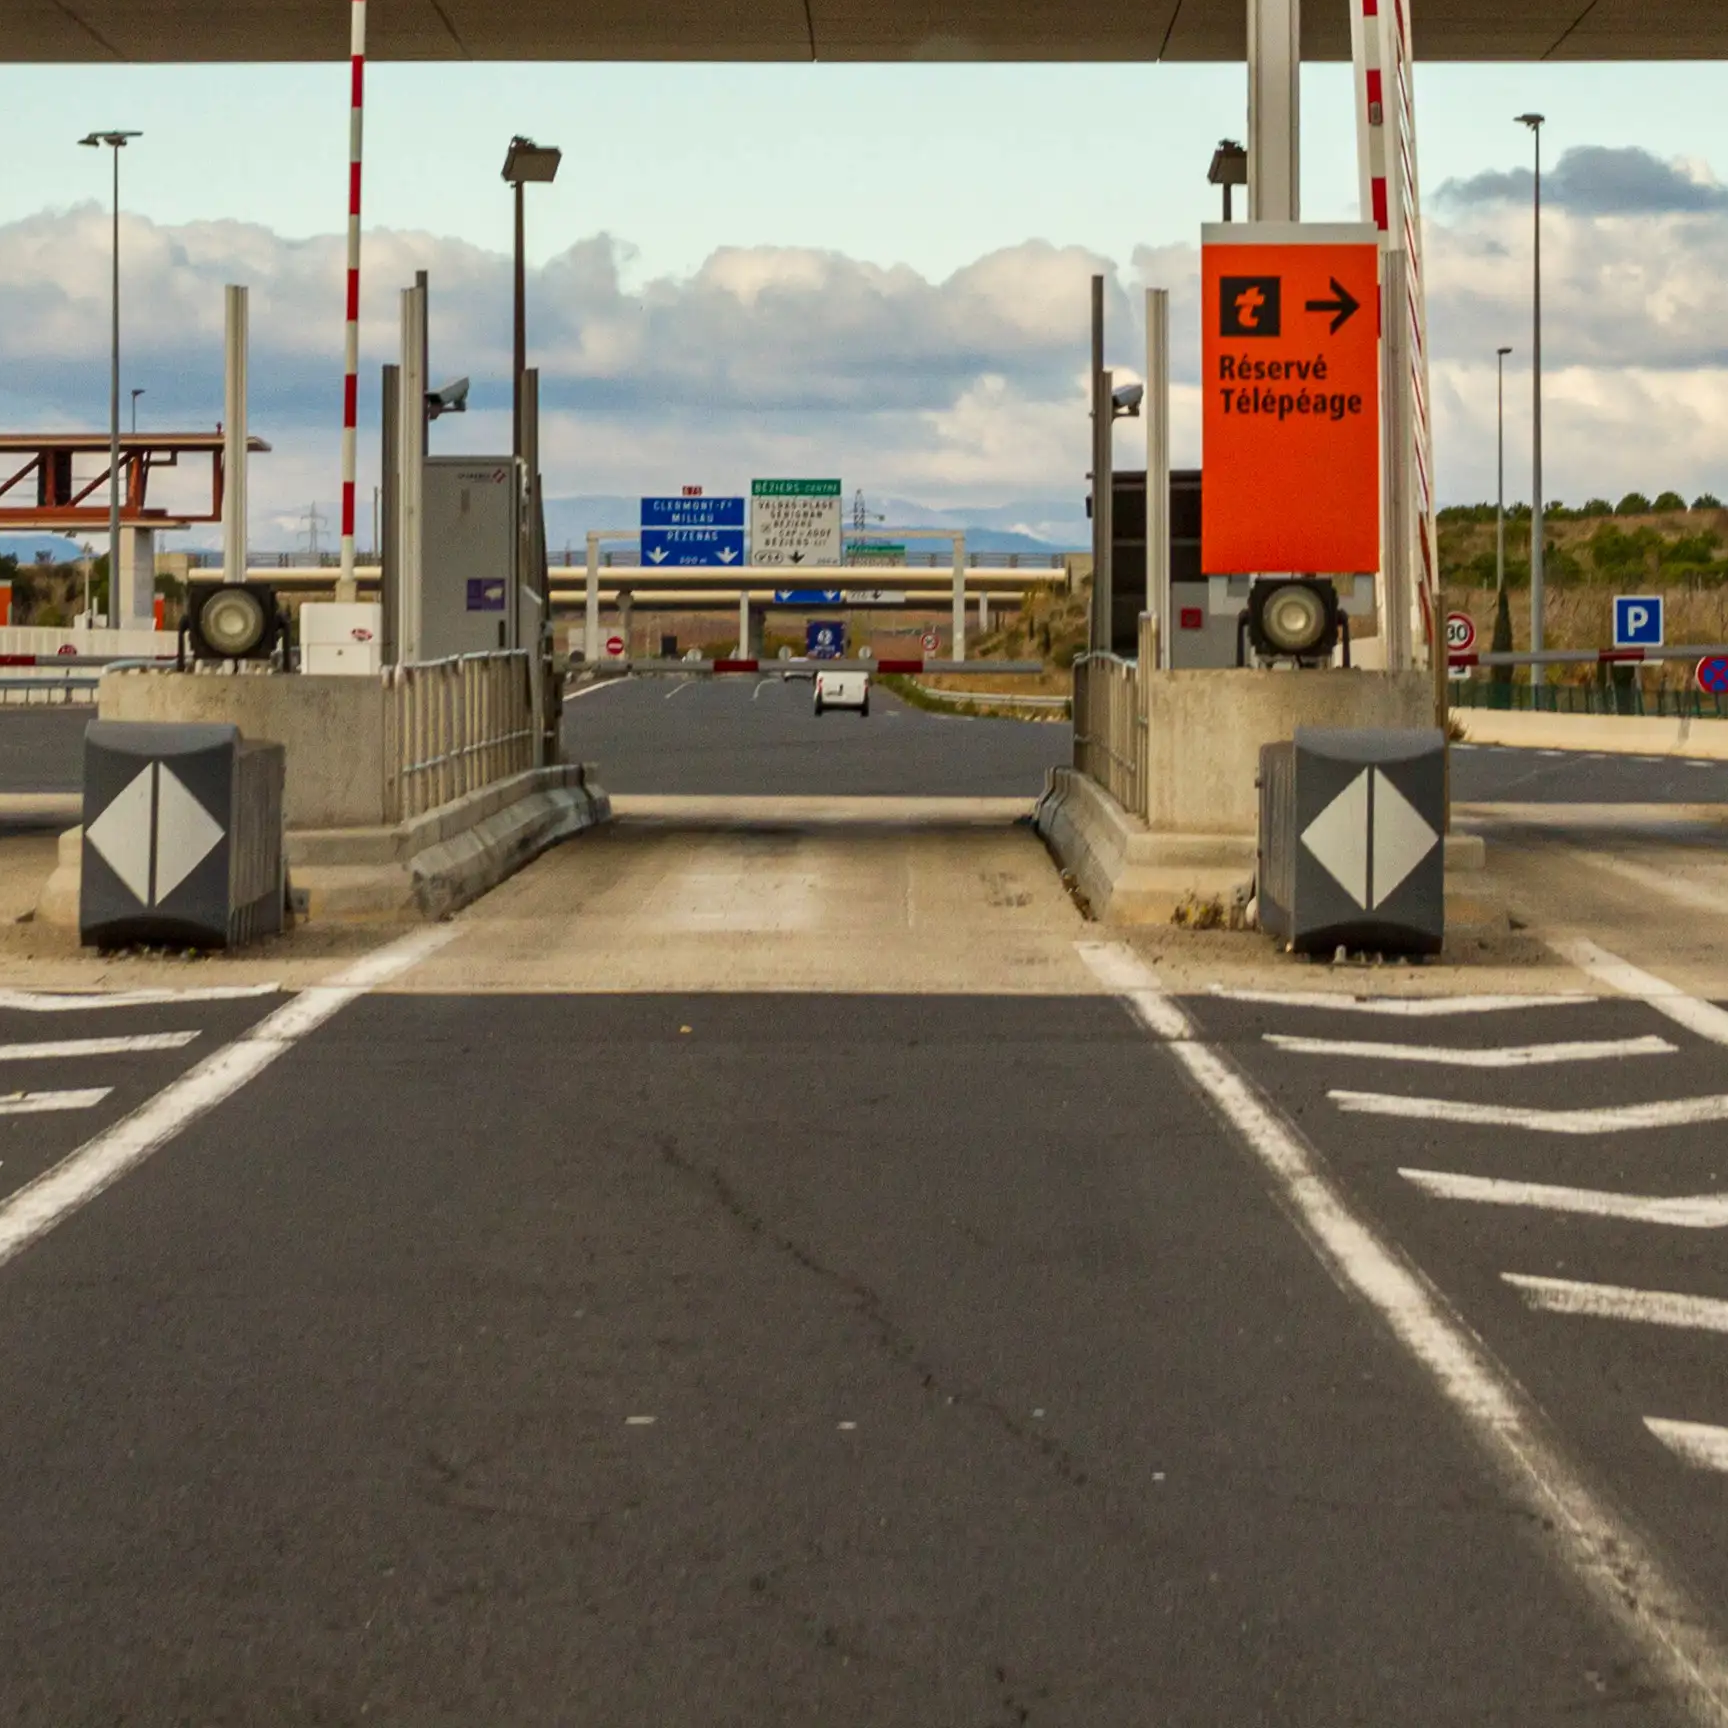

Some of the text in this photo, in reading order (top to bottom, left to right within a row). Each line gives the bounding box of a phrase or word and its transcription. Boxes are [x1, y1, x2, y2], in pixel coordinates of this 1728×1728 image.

[1219, 354, 1327, 380] Réservé
[1220, 388, 1362, 420] Télépéage
[672, 513, 714, 523] MILLAU
[1448, 624, 1469, 640] 30
[1627, 605, 1649, 637] P
